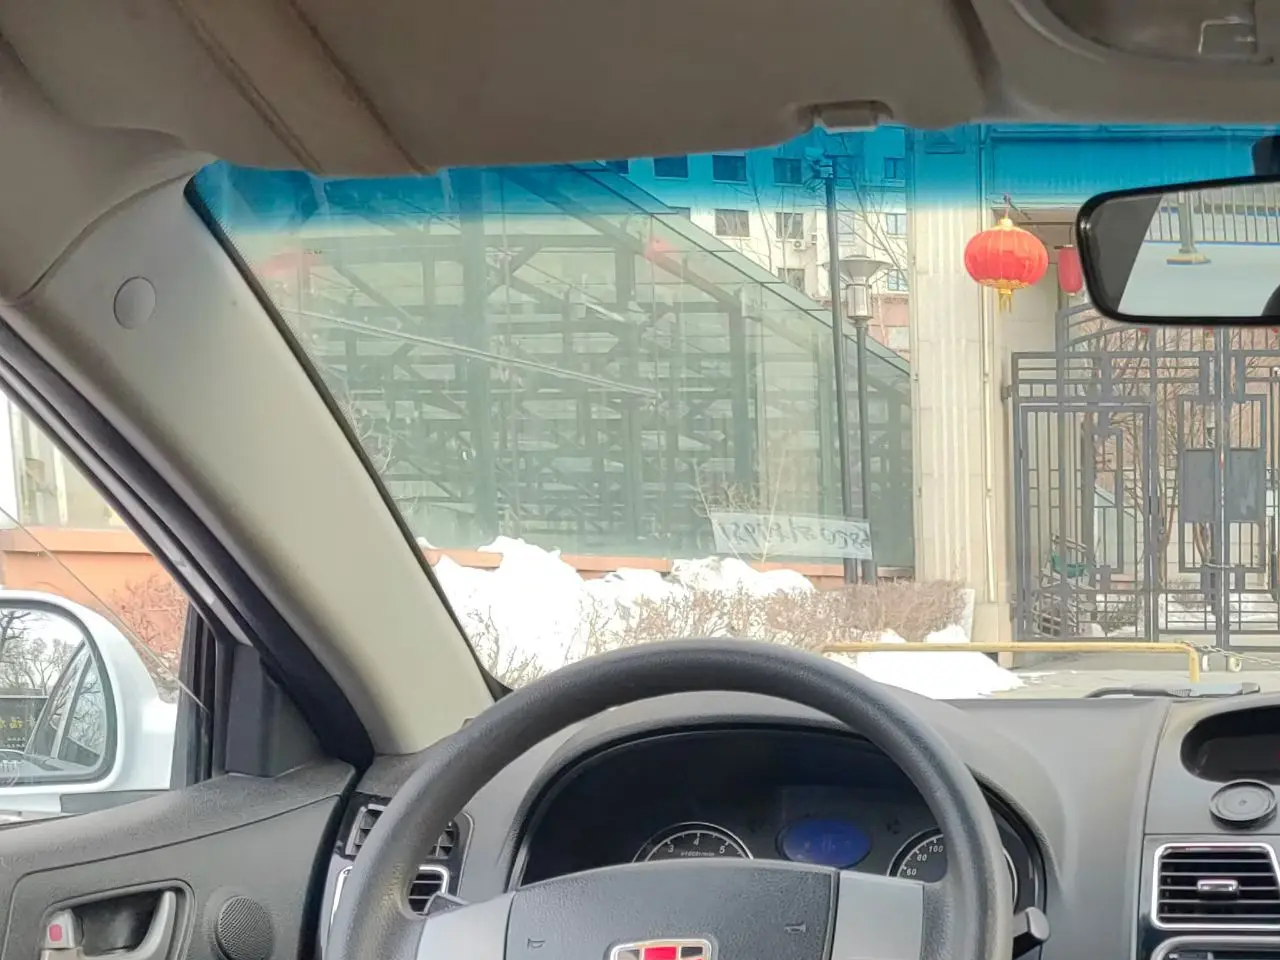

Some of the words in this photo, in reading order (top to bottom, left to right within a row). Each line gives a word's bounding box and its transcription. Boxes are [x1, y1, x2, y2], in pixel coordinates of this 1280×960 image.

[668, 844, 674, 853] 3
[693, 837, 700, 846] 4
[928, 845, 944, 853] 100
[906, 868, 917, 876] 60
